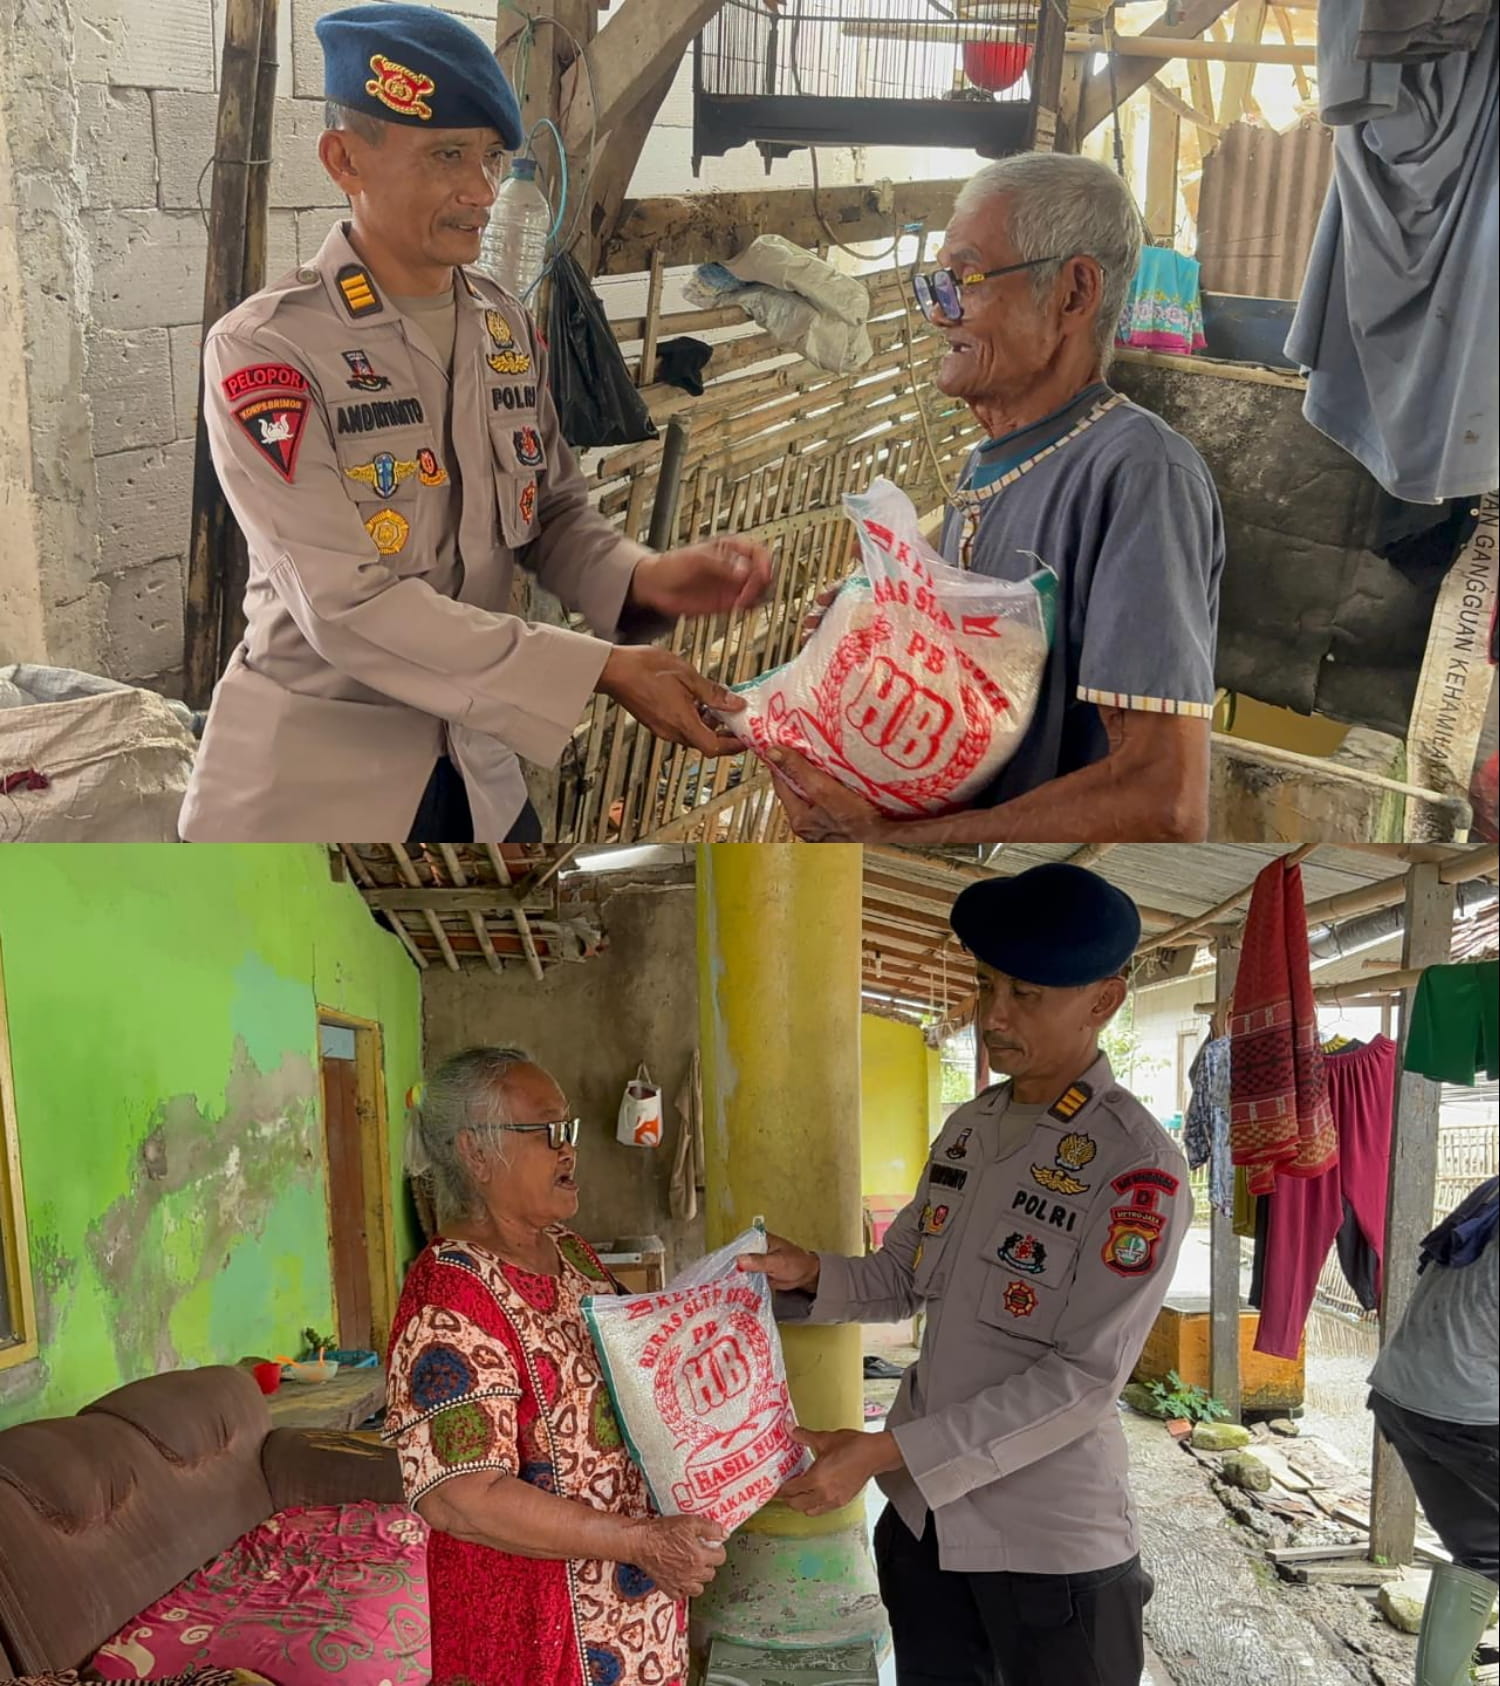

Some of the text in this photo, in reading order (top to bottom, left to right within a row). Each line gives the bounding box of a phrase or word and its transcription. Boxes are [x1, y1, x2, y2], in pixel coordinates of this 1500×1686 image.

[227, 367, 301, 395] PELOPOR
[1453, 534, 1495, 653] GANGGUAN
[906, 629, 946, 675] PB
[846, 656, 954, 770] HB
[1011, 1189, 1077, 1232] POLRI
[639, 1312, 683, 1368] BERAS
[682, 1334, 751, 1416] HB
[693, 1452, 754, 1492] HASIL
